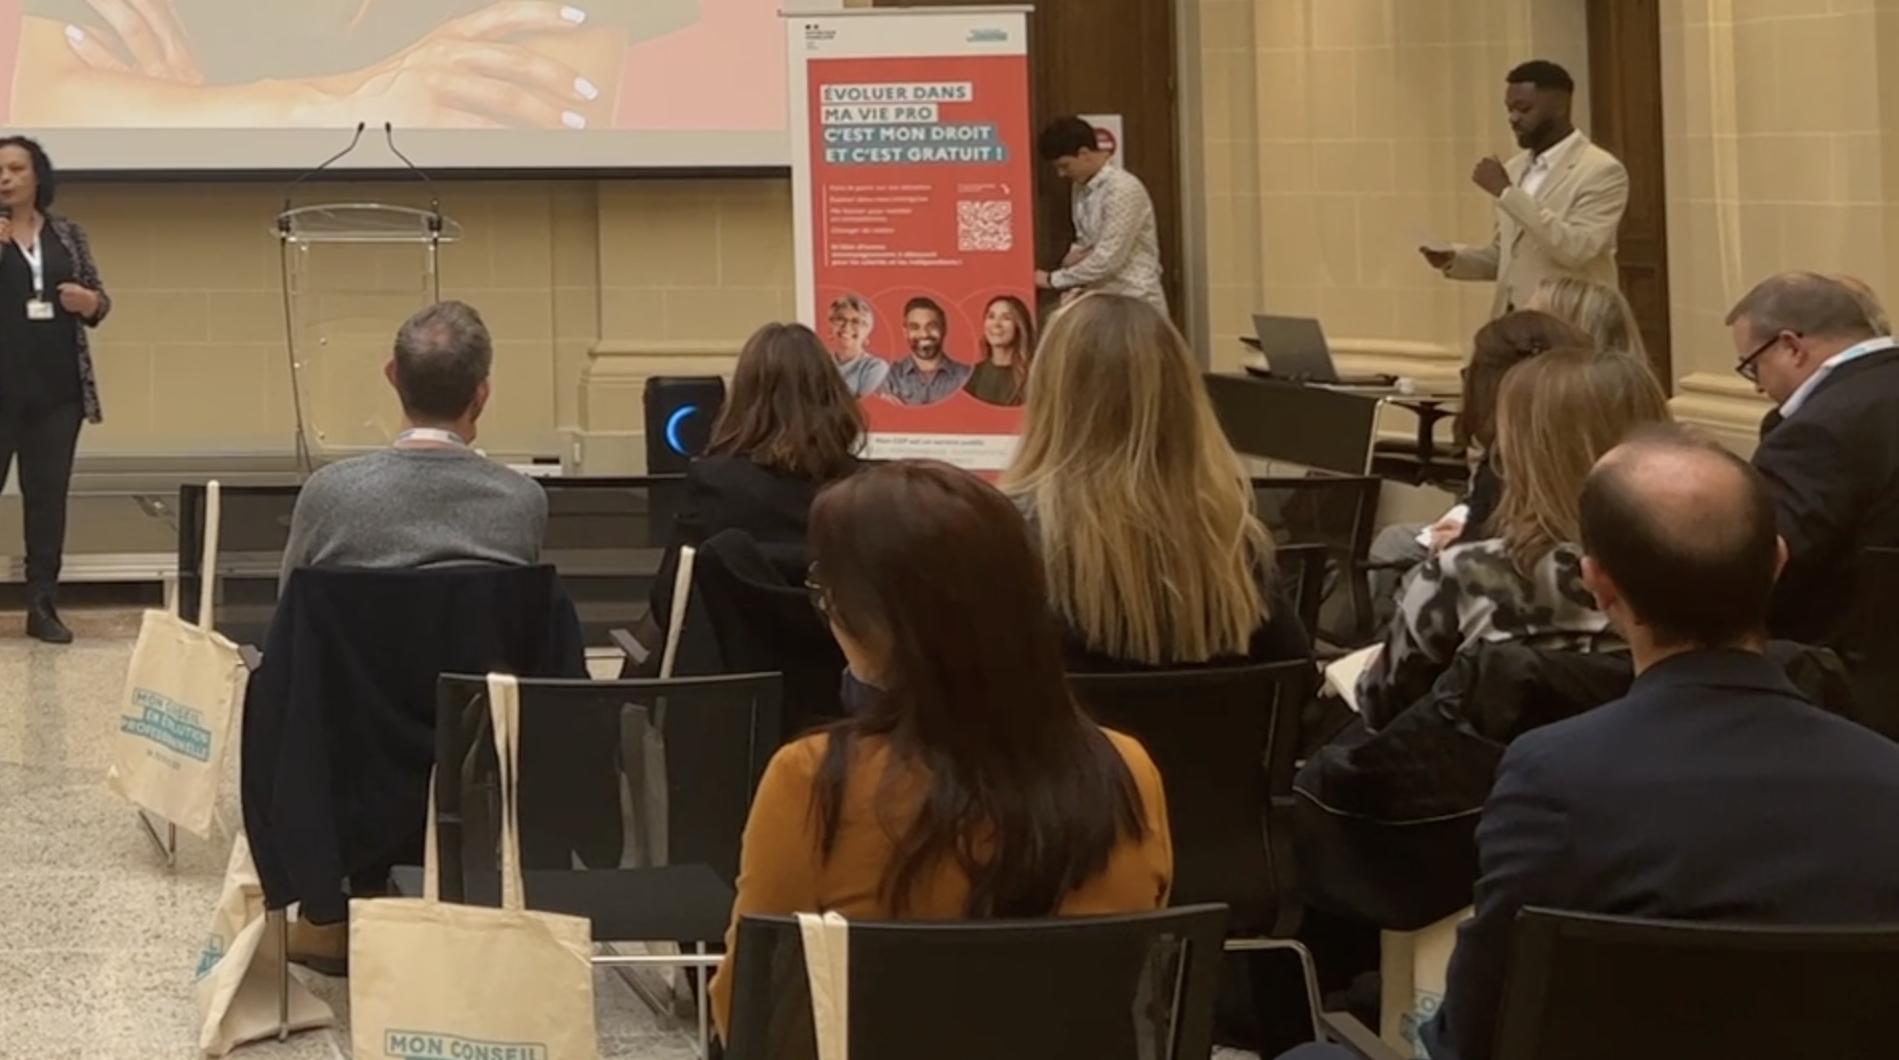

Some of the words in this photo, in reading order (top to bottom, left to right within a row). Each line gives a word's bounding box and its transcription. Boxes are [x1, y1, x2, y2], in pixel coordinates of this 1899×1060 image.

[823, 85, 908, 101] ÉVOLUER
[913, 86, 966, 99] DANS
[824, 108, 853, 121] MA
[858, 107, 888, 120] VIE
[895, 107, 932, 120] PRO
[824, 127, 875, 142] C'EST
[880, 126, 926, 141] MON
[931, 126, 992, 141] DROIT
[825, 148, 848, 162] ET
[852, 148, 901, 162] C'EST
[906, 146, 992, 161] GRATUIT
[995, 146, 1003, 161] !
[389, 1035, 443, 1055] MON
[450, 1041, 537, 1060] CONSEIL
